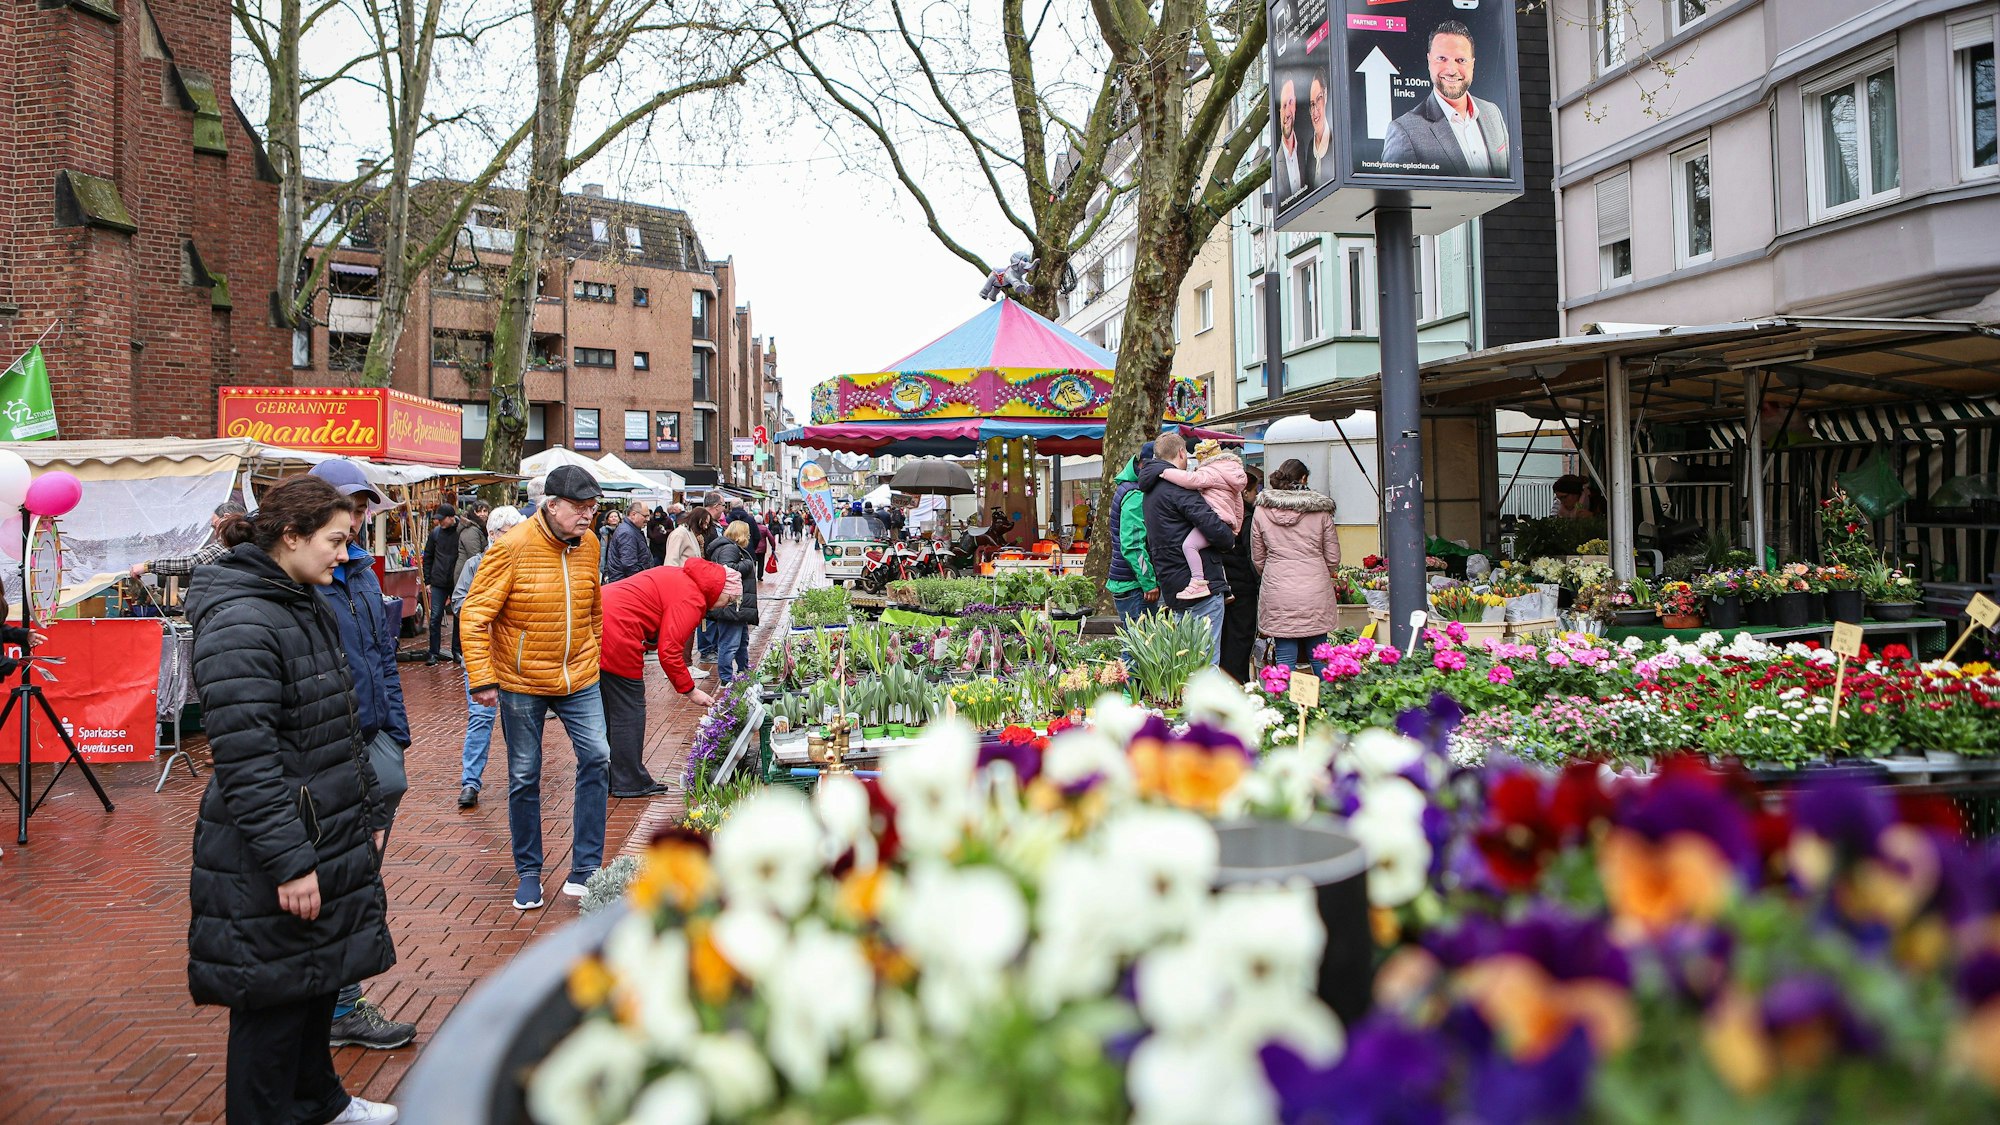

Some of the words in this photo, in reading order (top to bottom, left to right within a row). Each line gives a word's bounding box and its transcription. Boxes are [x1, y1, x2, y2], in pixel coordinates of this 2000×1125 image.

[1352, 18, 1378, 27] PARTNER
[1393, 77, 1402, 86] in
[1405, 78, 1430, 87] 100m
[1394, 89, 1415, 98] links
[1361, 160, 1440, 170] handystore-opladen.de
[255, 401, 348, 415] GEBRANNTE
[12, 407, 34, 423] 72
[34, 408, 54, 419] STUND
[227, 417, 376, 444] Mandeln
[389, 408, 413, 442] Süße
[413, 415, 459, 446] Spezialitäten
[78, 726, 127, 740] Sparkasse
[77, 742, 134, 753] Leverkusen
